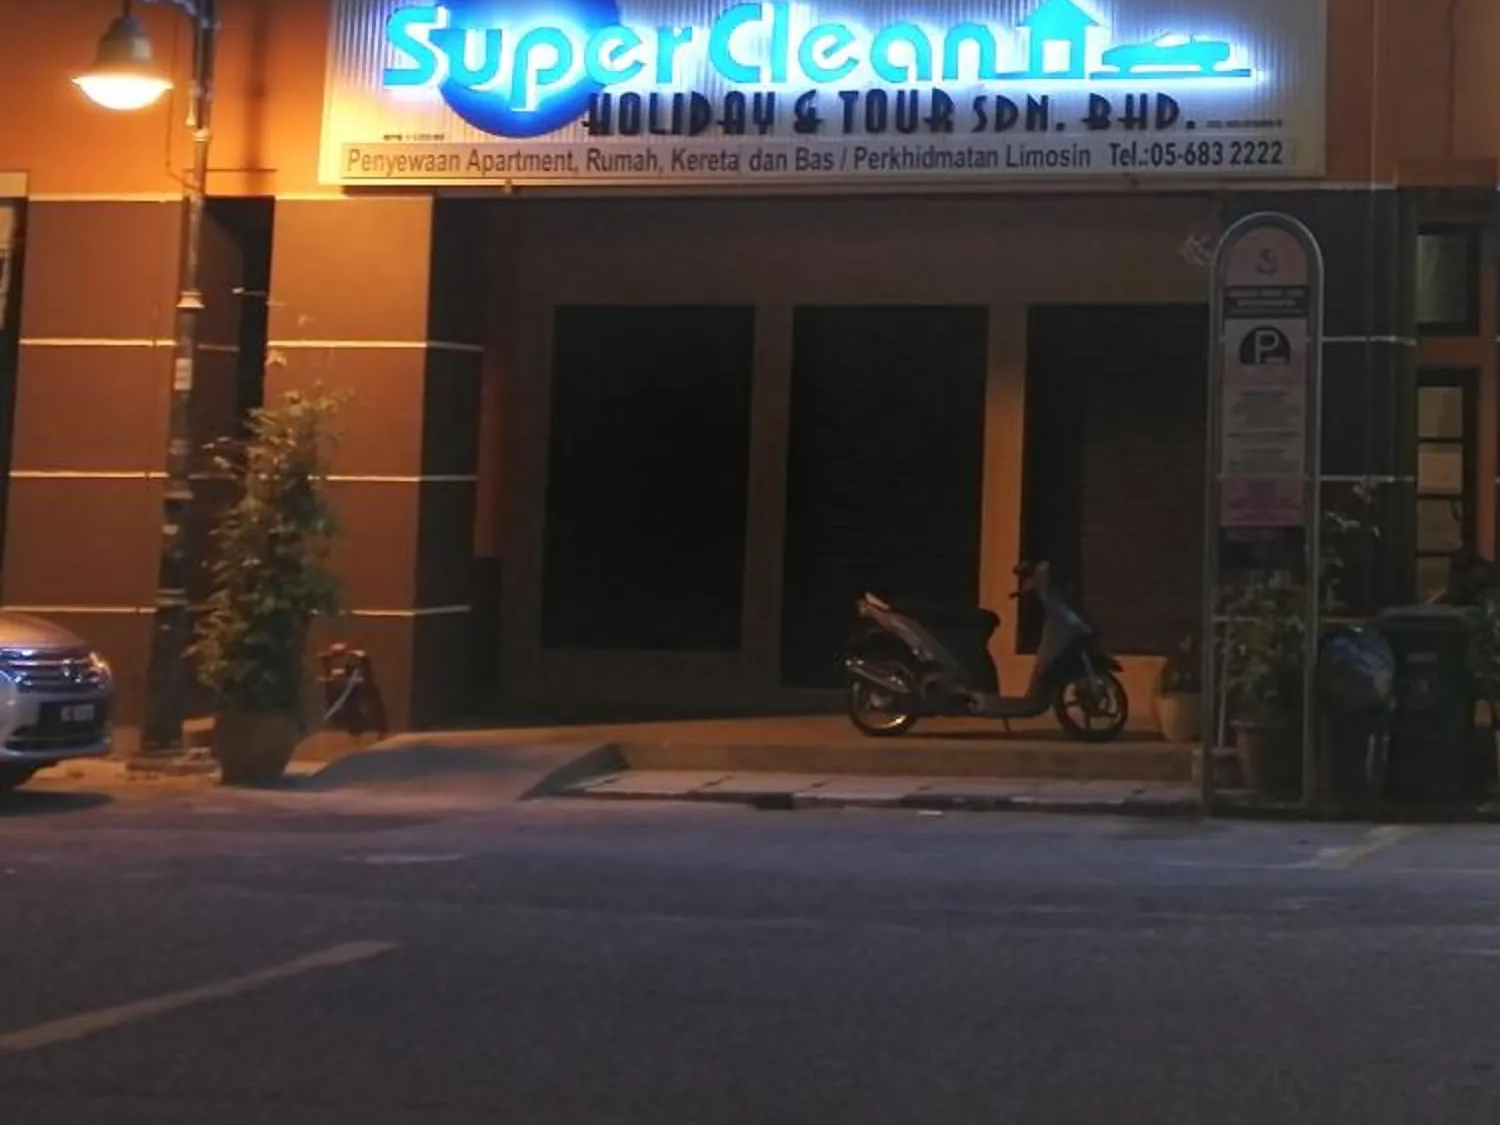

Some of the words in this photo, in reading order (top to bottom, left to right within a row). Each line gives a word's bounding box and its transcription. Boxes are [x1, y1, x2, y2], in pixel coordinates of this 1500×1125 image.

[580, 89, 778, 136] HOLIDAY
[793, 90, 824, 134] &
[839, 88, 956, 135] TOUR
[972, 92, 1066, 133] SDN.
[1082, 91, 1197, 133] BHD.
[346, 147, 461, 179] Penyewaan
[466, 147, 579, 177] Apartment,
[586, 148, 665, 175] Rumah,
[671, 147, 739, 173] Kereta
[749, 147, 788, 173] dan
[796, 146, 835, 172] Bas
[854, 144, 998, 171] Perkhidmatan
[1006, 144, 1091, 169] Limosin
[1230, 141, 1284, 167] 2222
